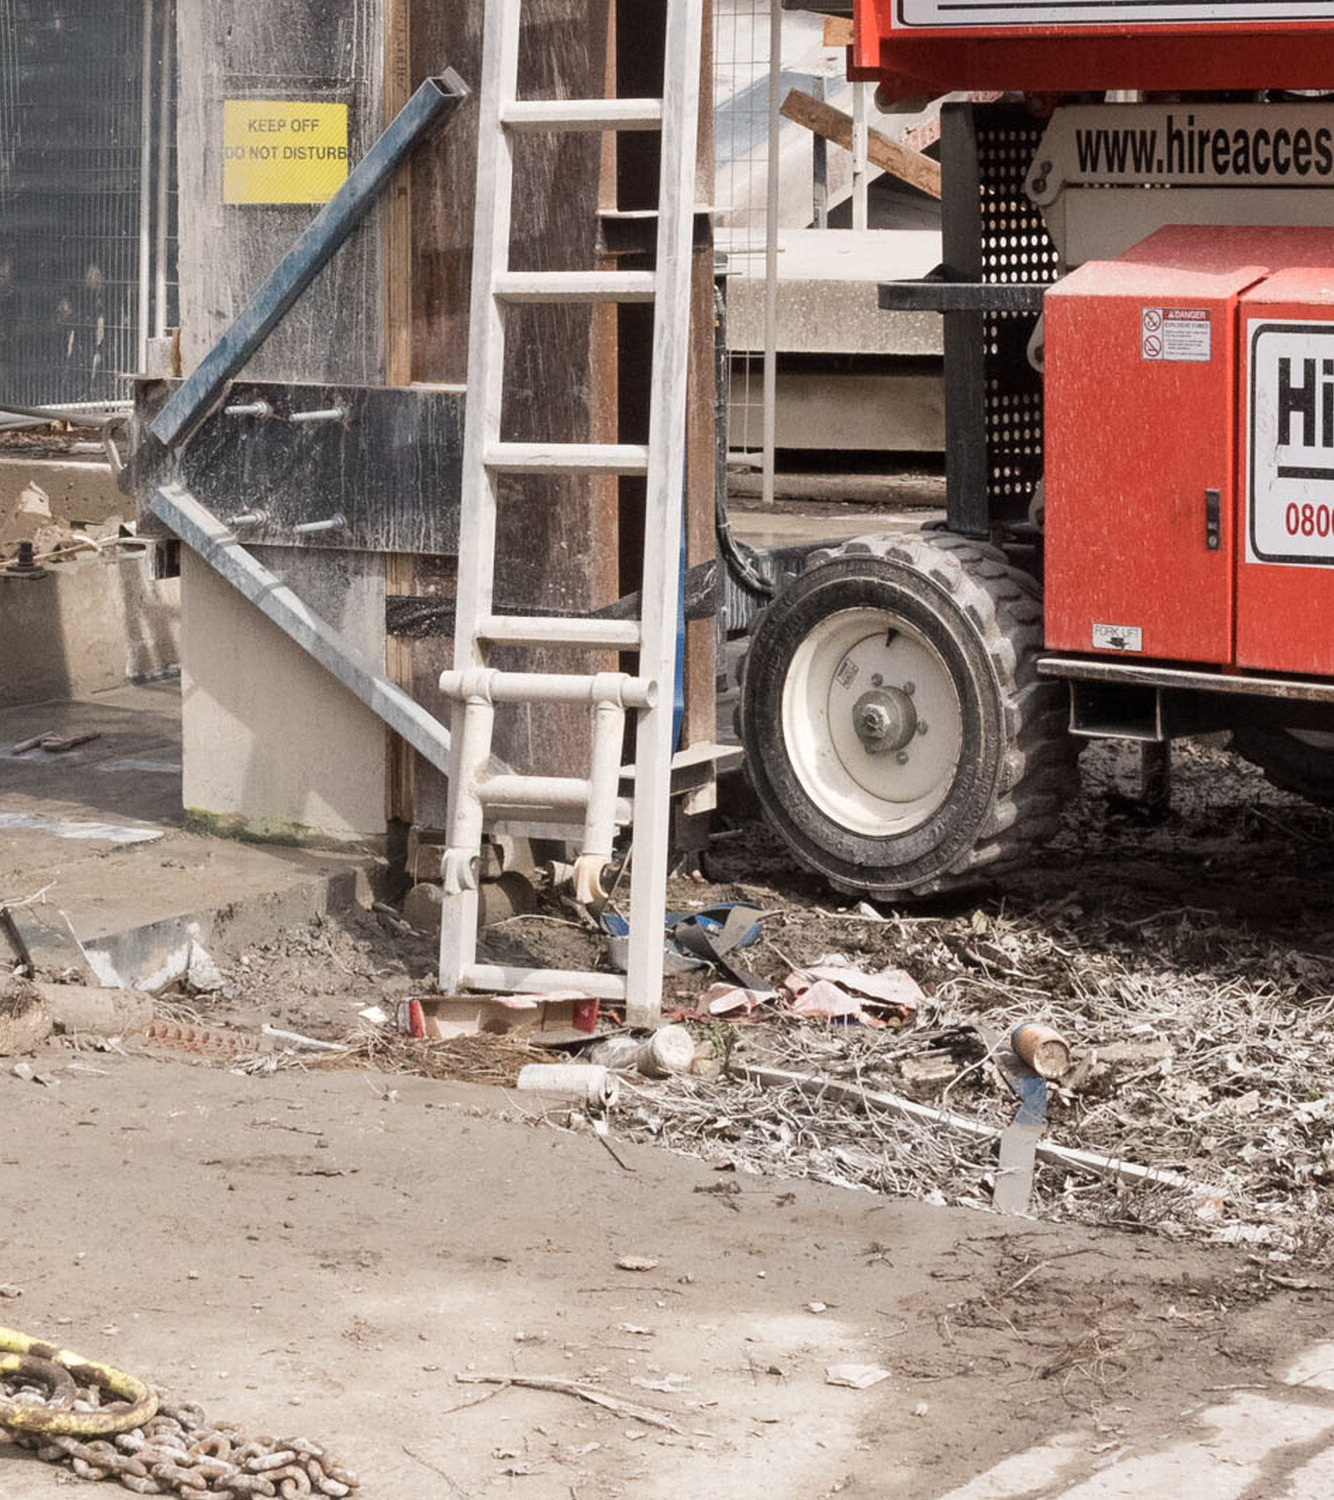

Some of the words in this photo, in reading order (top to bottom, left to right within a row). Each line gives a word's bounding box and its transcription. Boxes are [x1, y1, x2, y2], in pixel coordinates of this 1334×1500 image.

[248, 119, 286, 132] KEEP
[290, 119, 320, 132] OFF
[225, 146, 245, 160] DO
[249, 146, 279, 160] NOT
[282, 146, 348, 160] DISTURB
